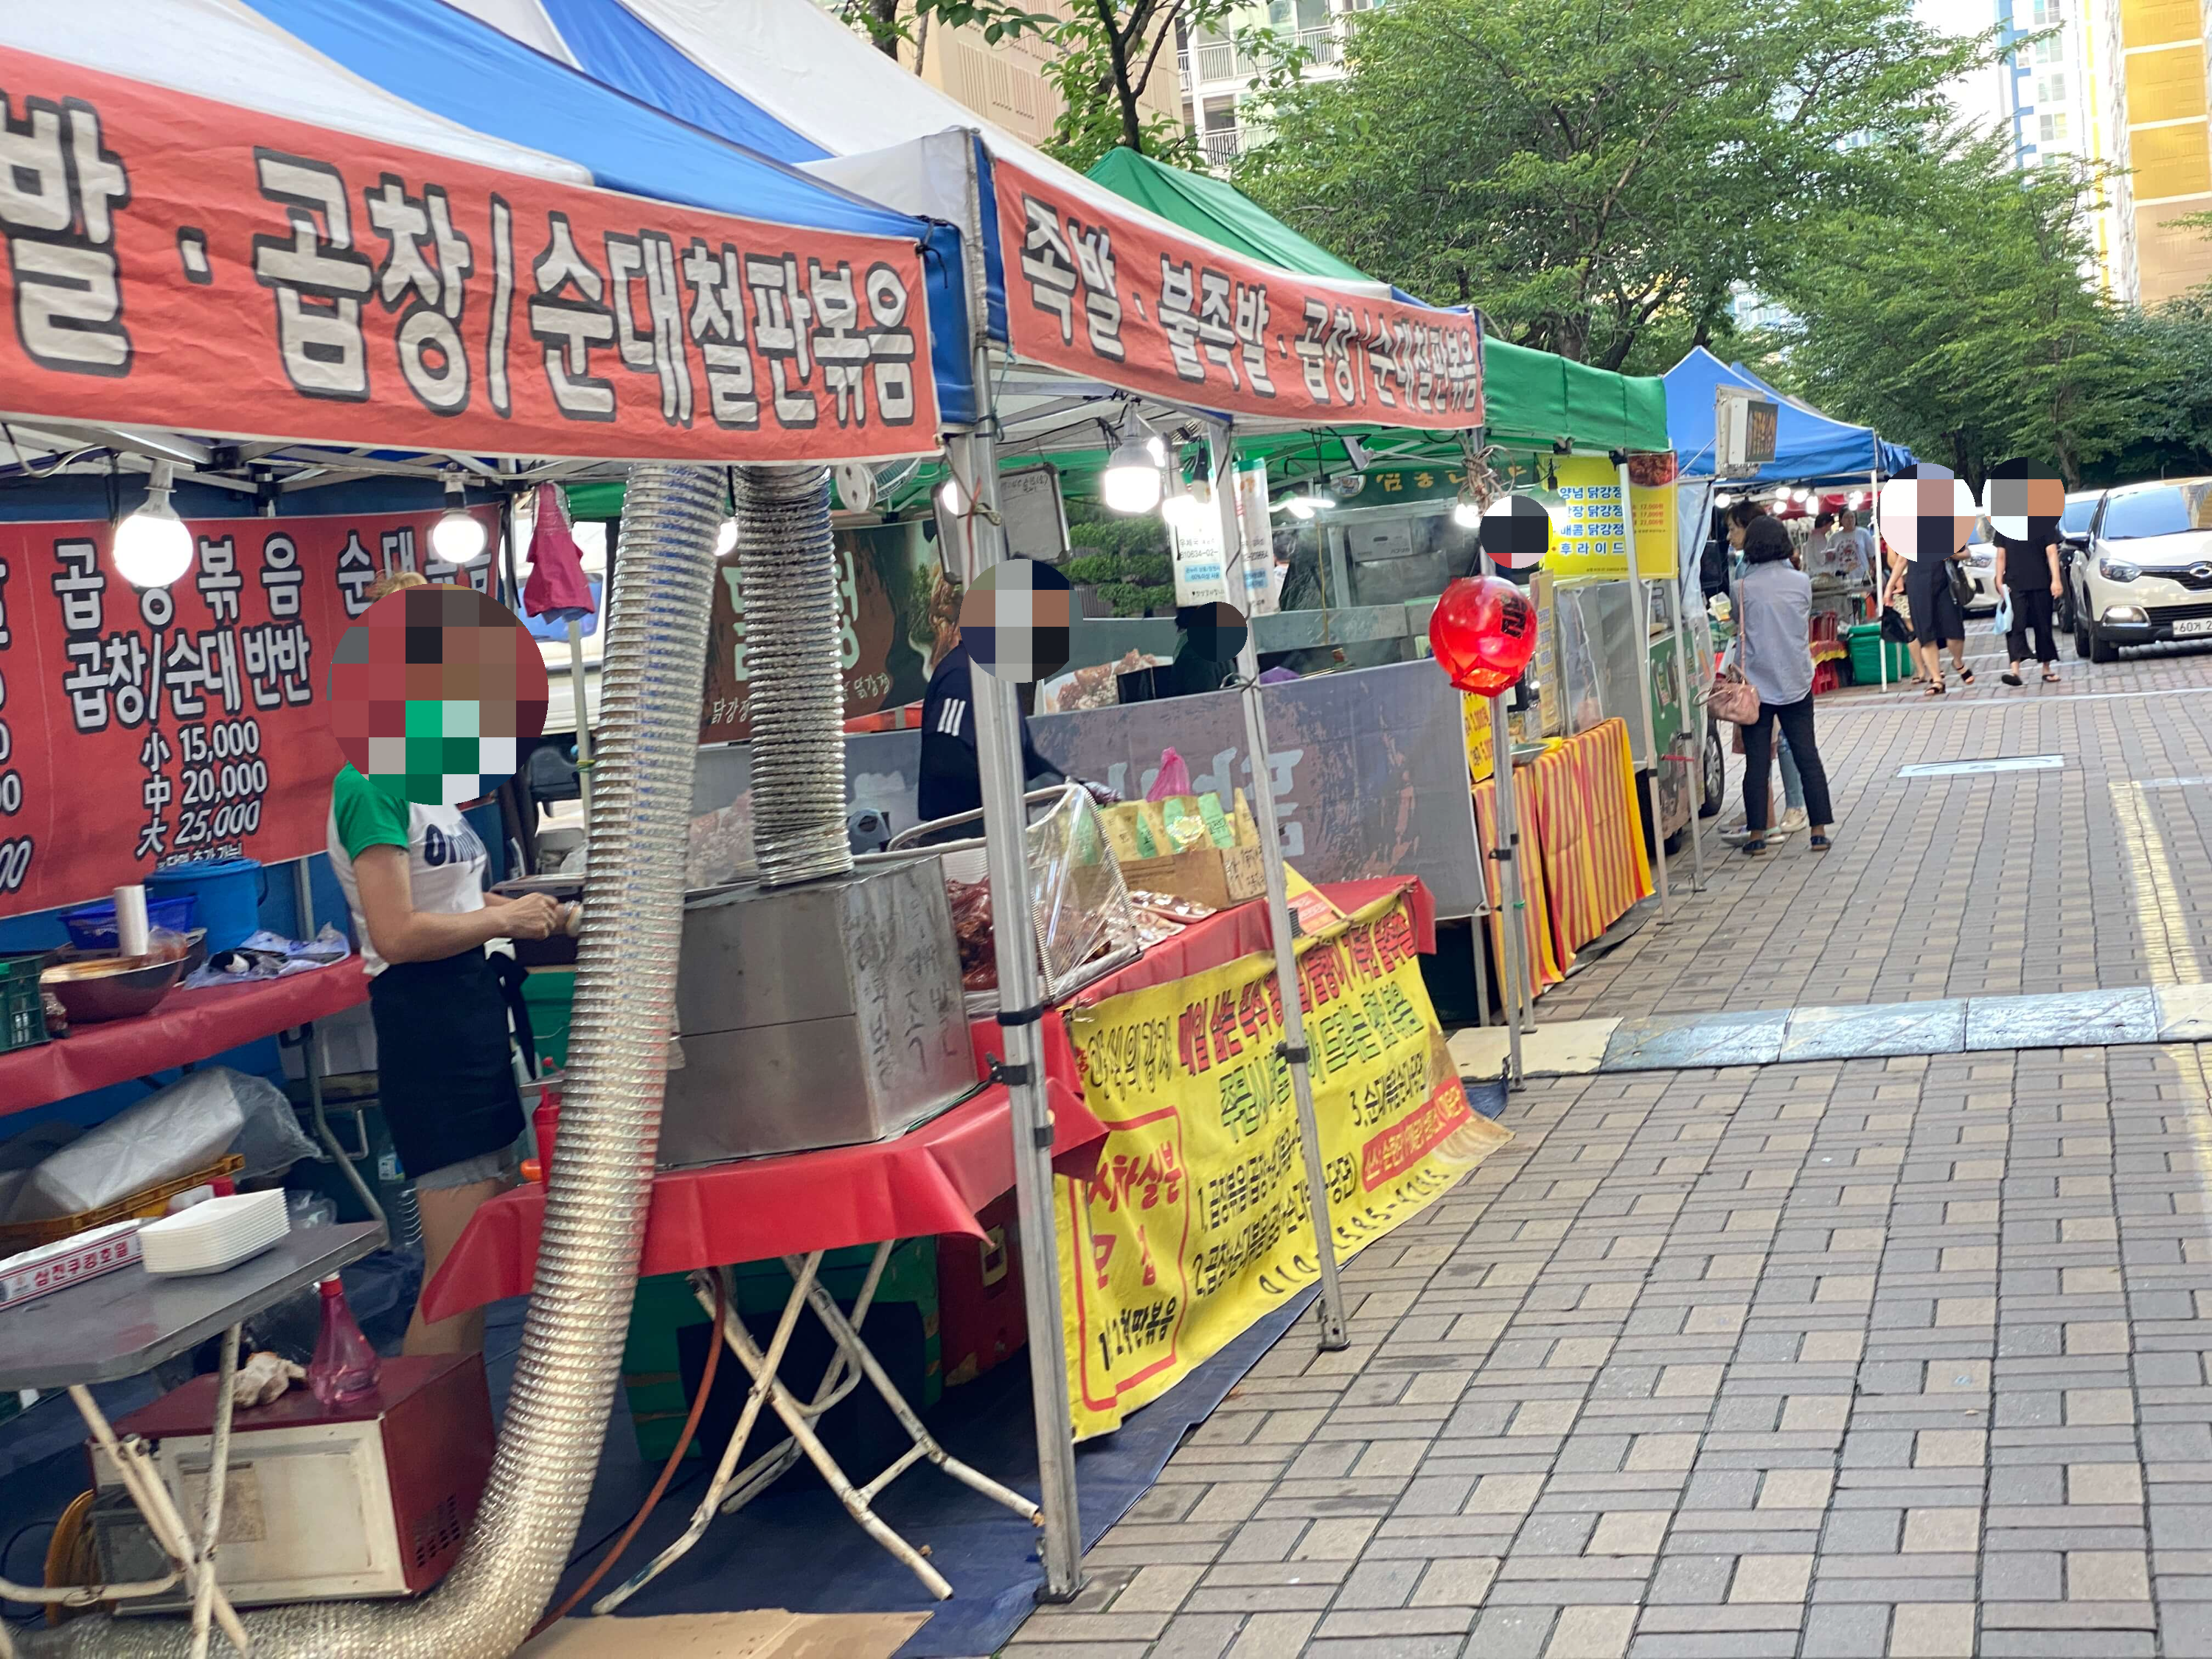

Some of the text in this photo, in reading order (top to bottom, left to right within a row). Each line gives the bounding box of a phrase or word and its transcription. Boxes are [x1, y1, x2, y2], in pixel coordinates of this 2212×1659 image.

[1559, 486, 1621, 499] 양념 닭강정
[1587, 505, 1622, 518] 닭강정
[1587, 524, 1624, 536] 닭강정
[178, 716, 260, 765] 15,000
[144, 759, 268, 816] 中 20,000
[134, 799, 262, 860] 大 25,000
[34, 1240, 129, 1287] 삼진쿠킹호일
